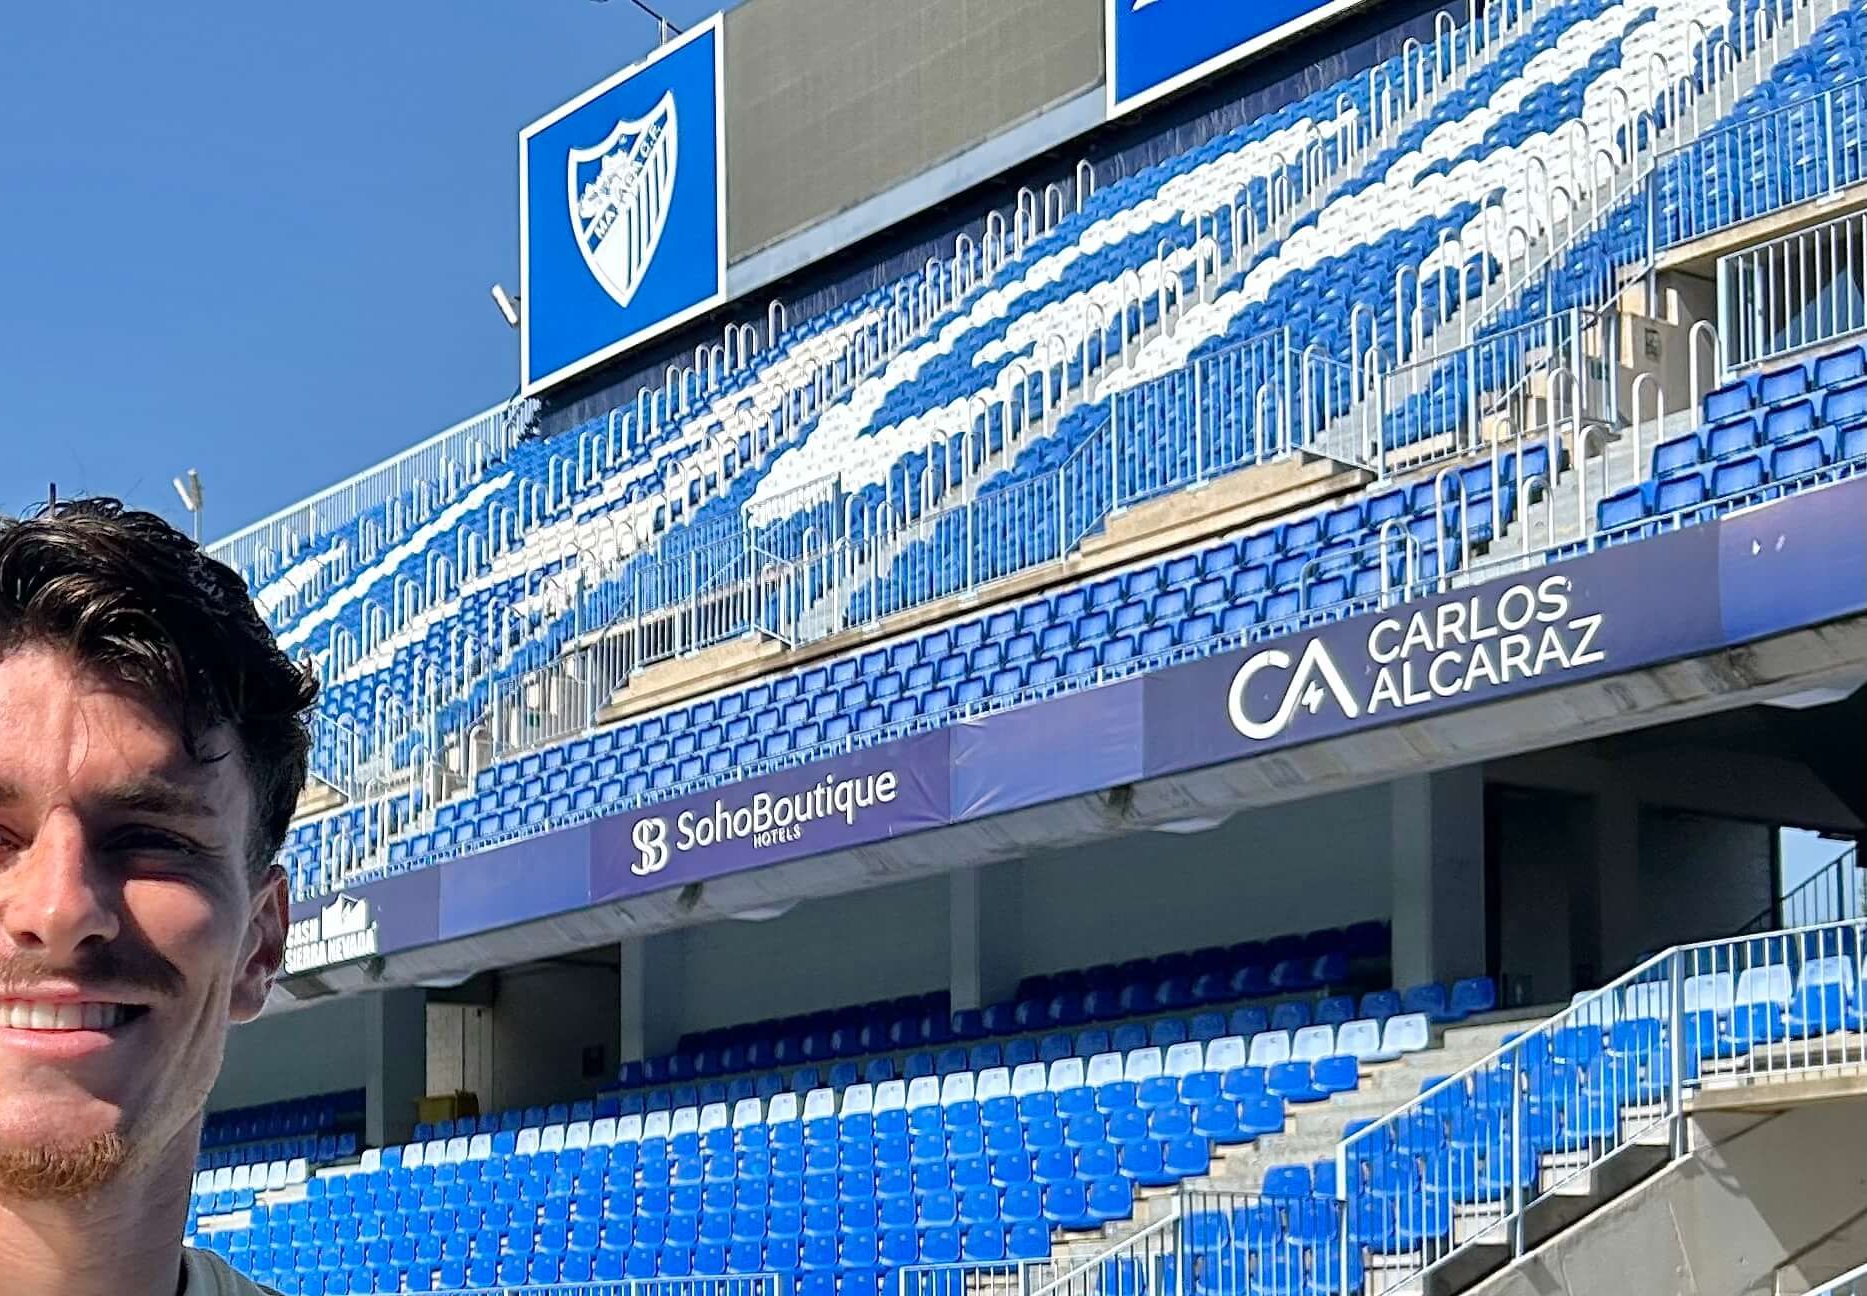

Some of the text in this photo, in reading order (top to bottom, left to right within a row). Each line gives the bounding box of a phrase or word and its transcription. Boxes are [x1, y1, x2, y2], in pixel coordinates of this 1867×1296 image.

[1368, 576, 1568, 663] CARLOS
[1368, 613, 1605, 714] ALCARAZ
[676, 771, 897, 850] SohoBoutique
[753, 824, 802, 848] HOTELS
[284, 927, 375, 975] SIERRA NEVADA
